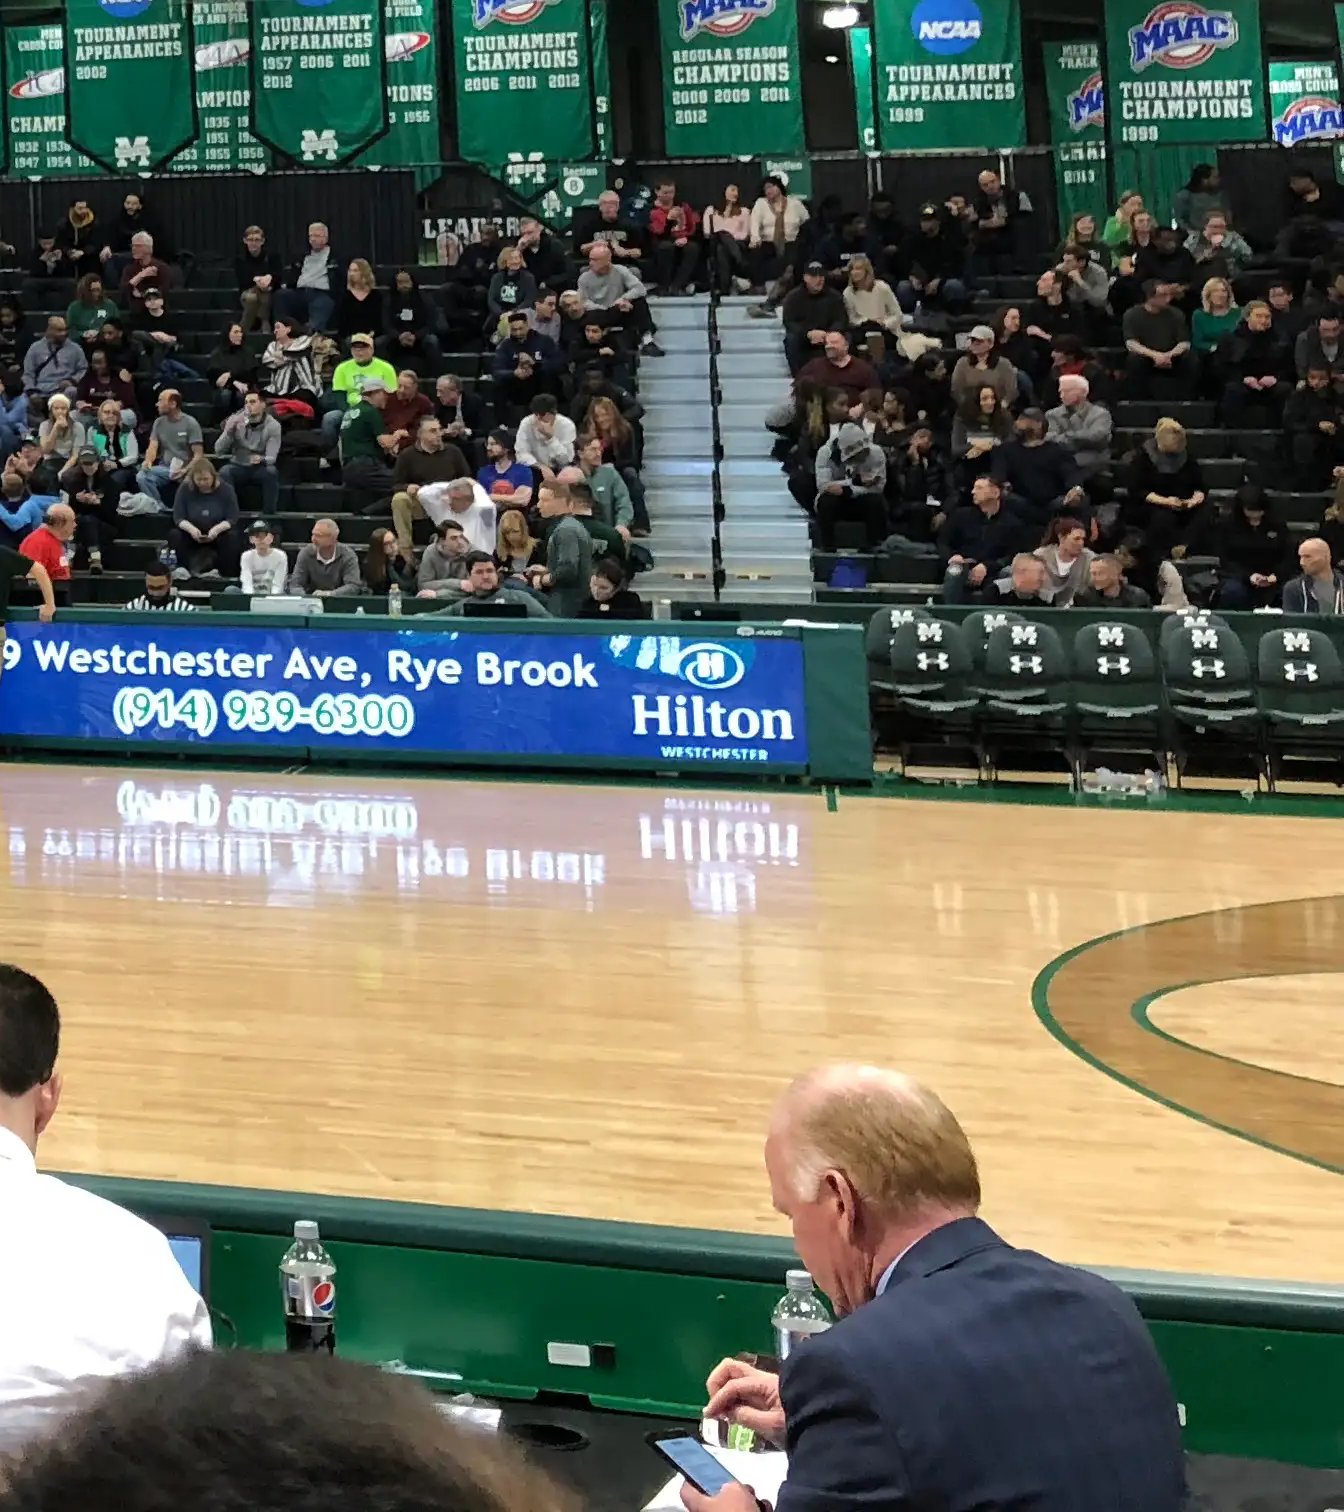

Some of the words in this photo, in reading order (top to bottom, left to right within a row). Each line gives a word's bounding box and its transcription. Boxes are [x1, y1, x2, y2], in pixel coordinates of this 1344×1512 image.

[74, 24, 181, 43] TOURNAMENT
[261, 15, 372, 33] TOURNAMENT
[919, 20, 980, 40] NCAA
[261, 32, 373, 51] APPEARANCES
[464, 32, 578, 52] TOURNAMENT
[1135, 15, 1229, 62] MAAC
[75, 42, 182, 61] APPEARANCES
[466, 49, 578, 71] CHAMPIONS
[673, 50, 732, 64] REGULAR
[737, 46, 787, 60] SEASON
[262, 56, 292, 70] 1957
[342, 54, 370, 67] 2011
[263, 75, 292, 88] 2012
[509, 76, 536, 88] 2011
[548, 74, 579, 88] 2012
[674, 62, 789, 84] CHAMPIONS
[886, 64, 1013, 82] TOURNAMENT
[887, 82, 1015, 101] APPEARANCES
[1120, 80, 1252, 98] TOURNAMENT
[1122, 98, 1253, 119] CHAMPIONS
[33, 640, 273, 678] Westchester
[284, 646, 372, 688] Ave,
[388, 649, 462, 691] Rye
[476, 652, 598, 688] Brook
[114, 688, 217, 736] (914)
[223, 691, 415, 736] 939-6300
[632, 695, 794, 740] Hilton
[661, 746, 768, 760] WESTCHESTER
